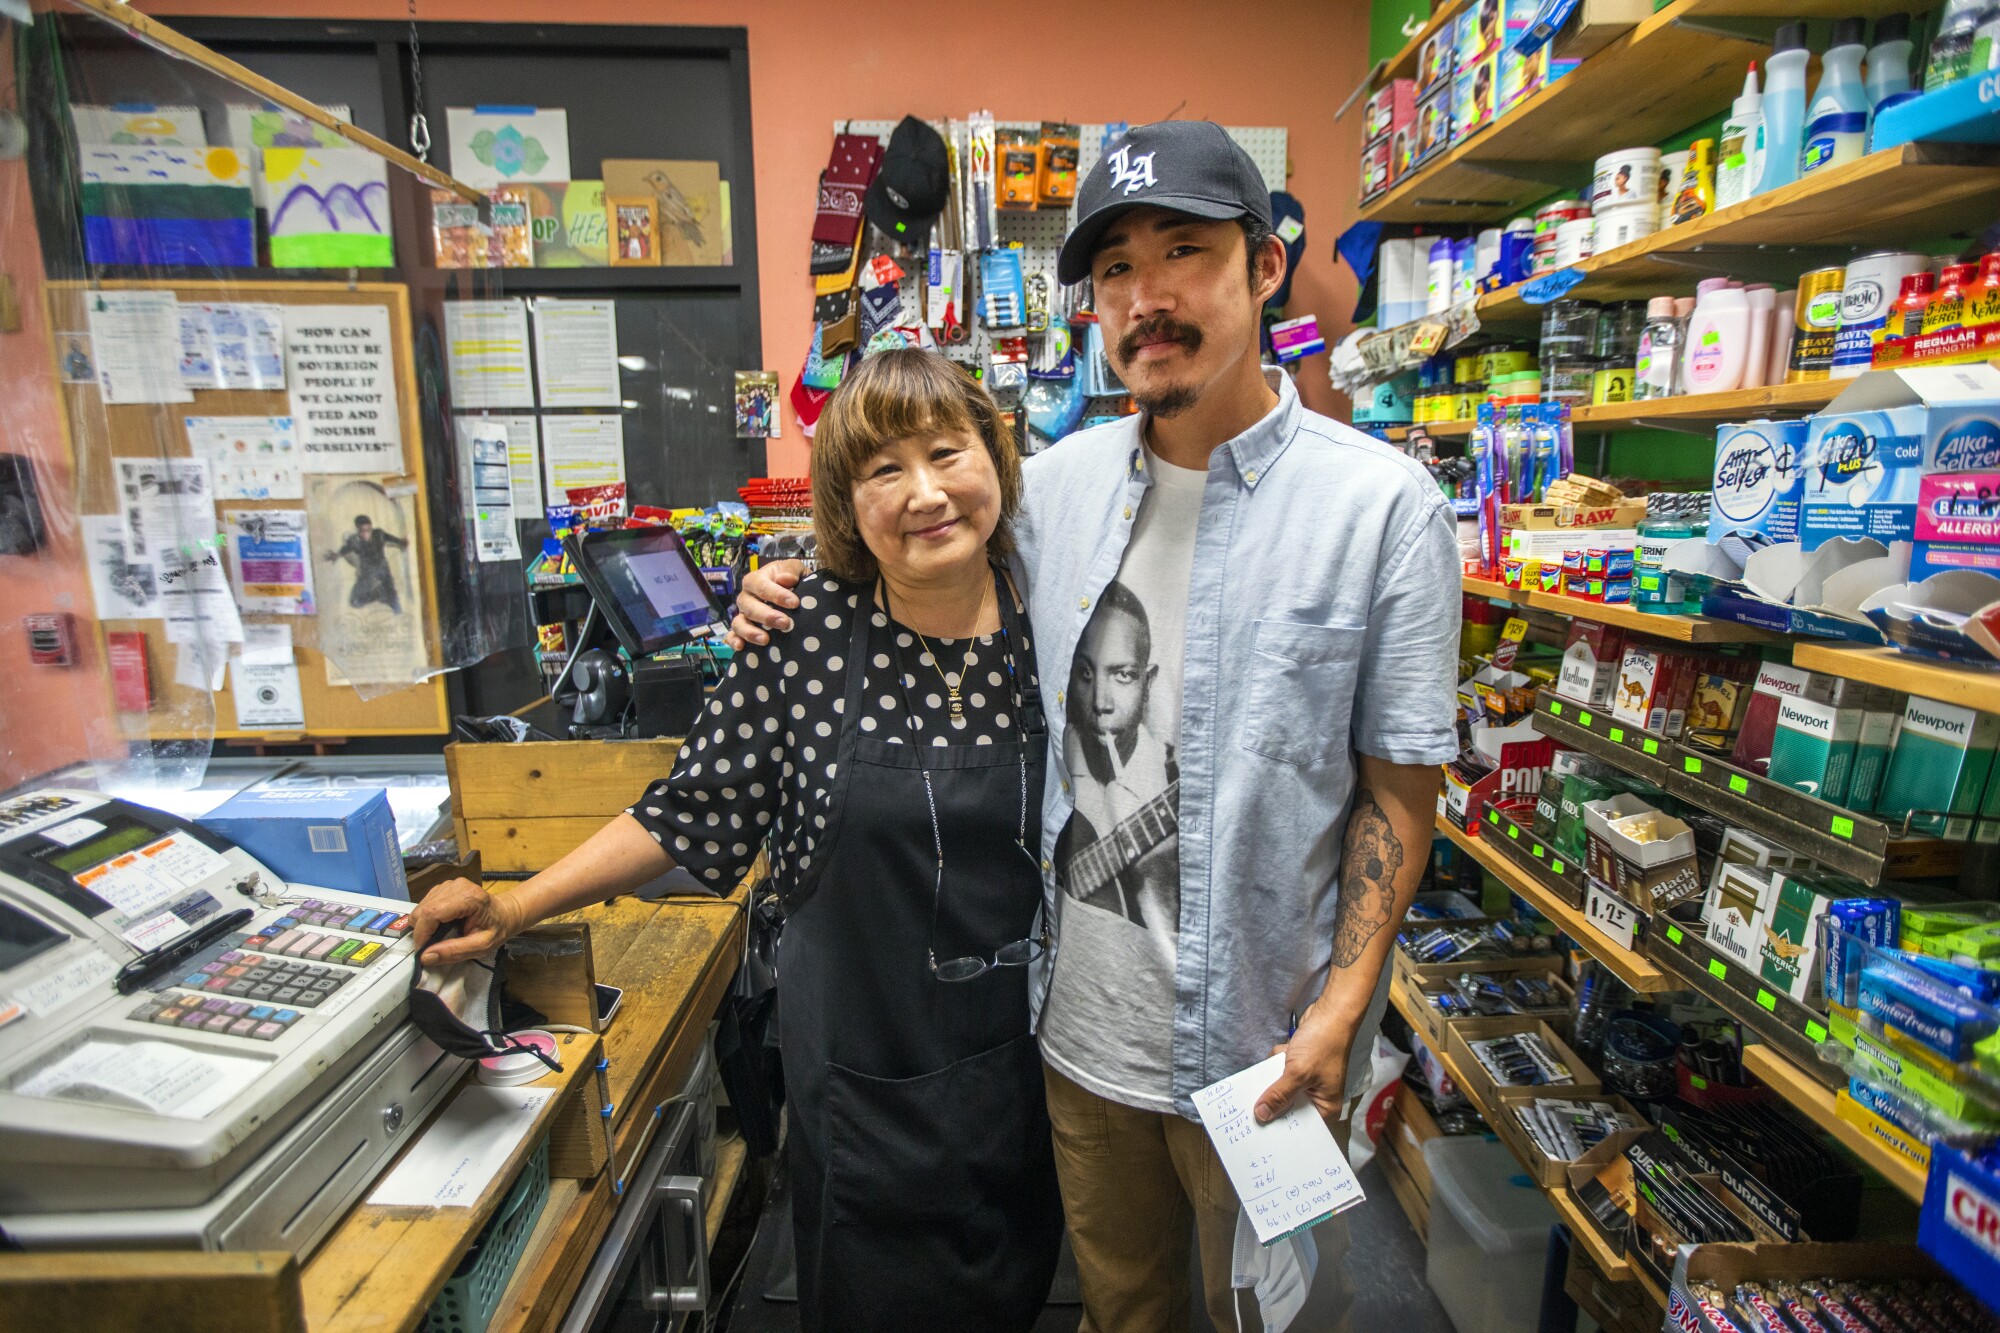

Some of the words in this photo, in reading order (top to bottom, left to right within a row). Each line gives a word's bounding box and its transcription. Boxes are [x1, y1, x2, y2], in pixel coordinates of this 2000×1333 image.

[1108, 144, 1158, 196] LA
[341, 327, 371, 338] CAN
[1835, 330, 1874, 341] HAVIN
[1914, 330, 1976, 350] REGULAR
[316, 345, 358, 355] TRULY
[364, 345, 382, 355] BE
[1834, 340, 1872, 351] OWDE
[1913, 342, 1976, 358] STRENGTH
[299, 361, 378, 371] SOVEREIGN
[305, 378, 358, 387] PEOPLE
[325, 394, 382, 404] CANNOT
[308, 411, 343, 420] FEED
[349, 411, 378, 420] AND
[314, 427, 376, 436] NOURISH
[1895, 446, 1918, 458] Cold
[1837, 458, 1862, 473] PLUS
[1503, 510, 1521, 523] RAW
[1573, 509, 1617, 526] RAW
[1936, 521, 2000, 537] ALLERGY
[1624, 657, 1655, 675] CAMEL
[1563, 667, 1590, 688] Marlboro
[1758, 673, 1801, 694] Newport
[1781, 706, 1830, 730] Newport
[1907, 708, 1966, 735] Newport
[1536, 798, 1557, 823] KOOL
[1562, 797, 1580, 818] KOOL
[1650, 867, 1695, 900] Black
[1666, 879, 1700, 902] Mild
[1711, 922, 1748, 960] Marlboro
[1761, 946, 1799, 977] MAVERICK
[1871, 996, 1938, 1038] Winterfresh
[1519, 1036, 1558, 1077] Panasonic
[1856, 1040, 1900, 1074] DOUBLEMINT
[1661, 1121, 1720, 1175] DRACELL
[1872, 1124, 1899, 1147] Juicy
[1900, 1141, 1926, 1167] Fruit
[1721, 1169, 1794, 1239] DURACELL
